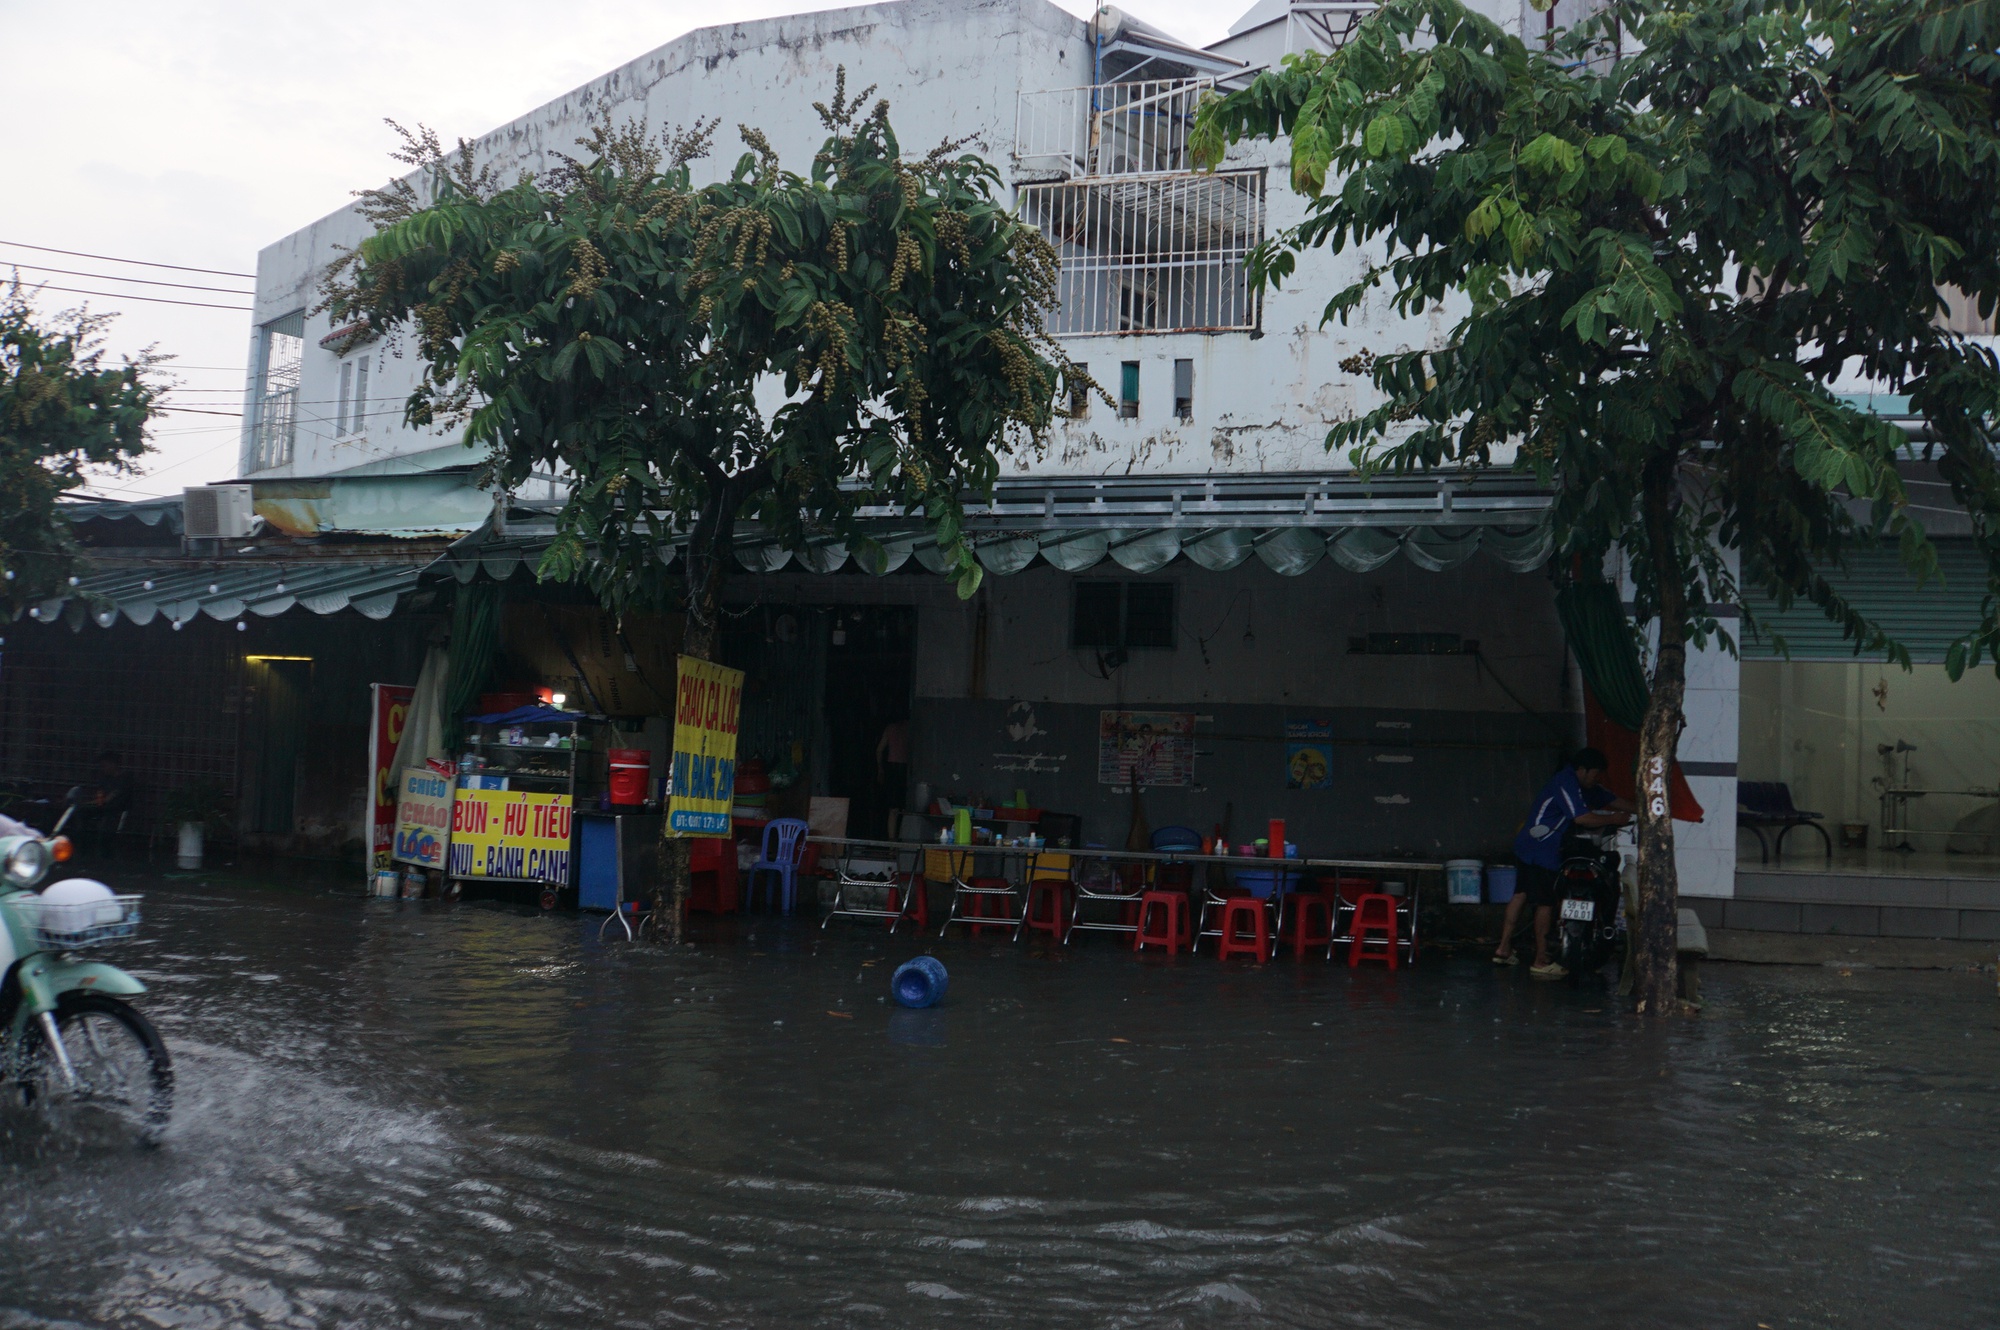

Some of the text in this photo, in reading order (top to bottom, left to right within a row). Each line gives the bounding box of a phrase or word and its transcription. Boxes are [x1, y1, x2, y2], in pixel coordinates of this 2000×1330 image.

[678, 664, 705, 728] CHÁO
[1650, 755, 1665, 816] 346
[401, 801, 448, 829] CHÁO
[452, 794, 488, 833] BÚN
[503, 792, 528, 836] HỦ
[533, 795, 571, 839] TIẾU
[450, 843, 474, 875] NUI
[486, 840, 524, 878] BÁNH
[528, 848, 569, 884] CANH
